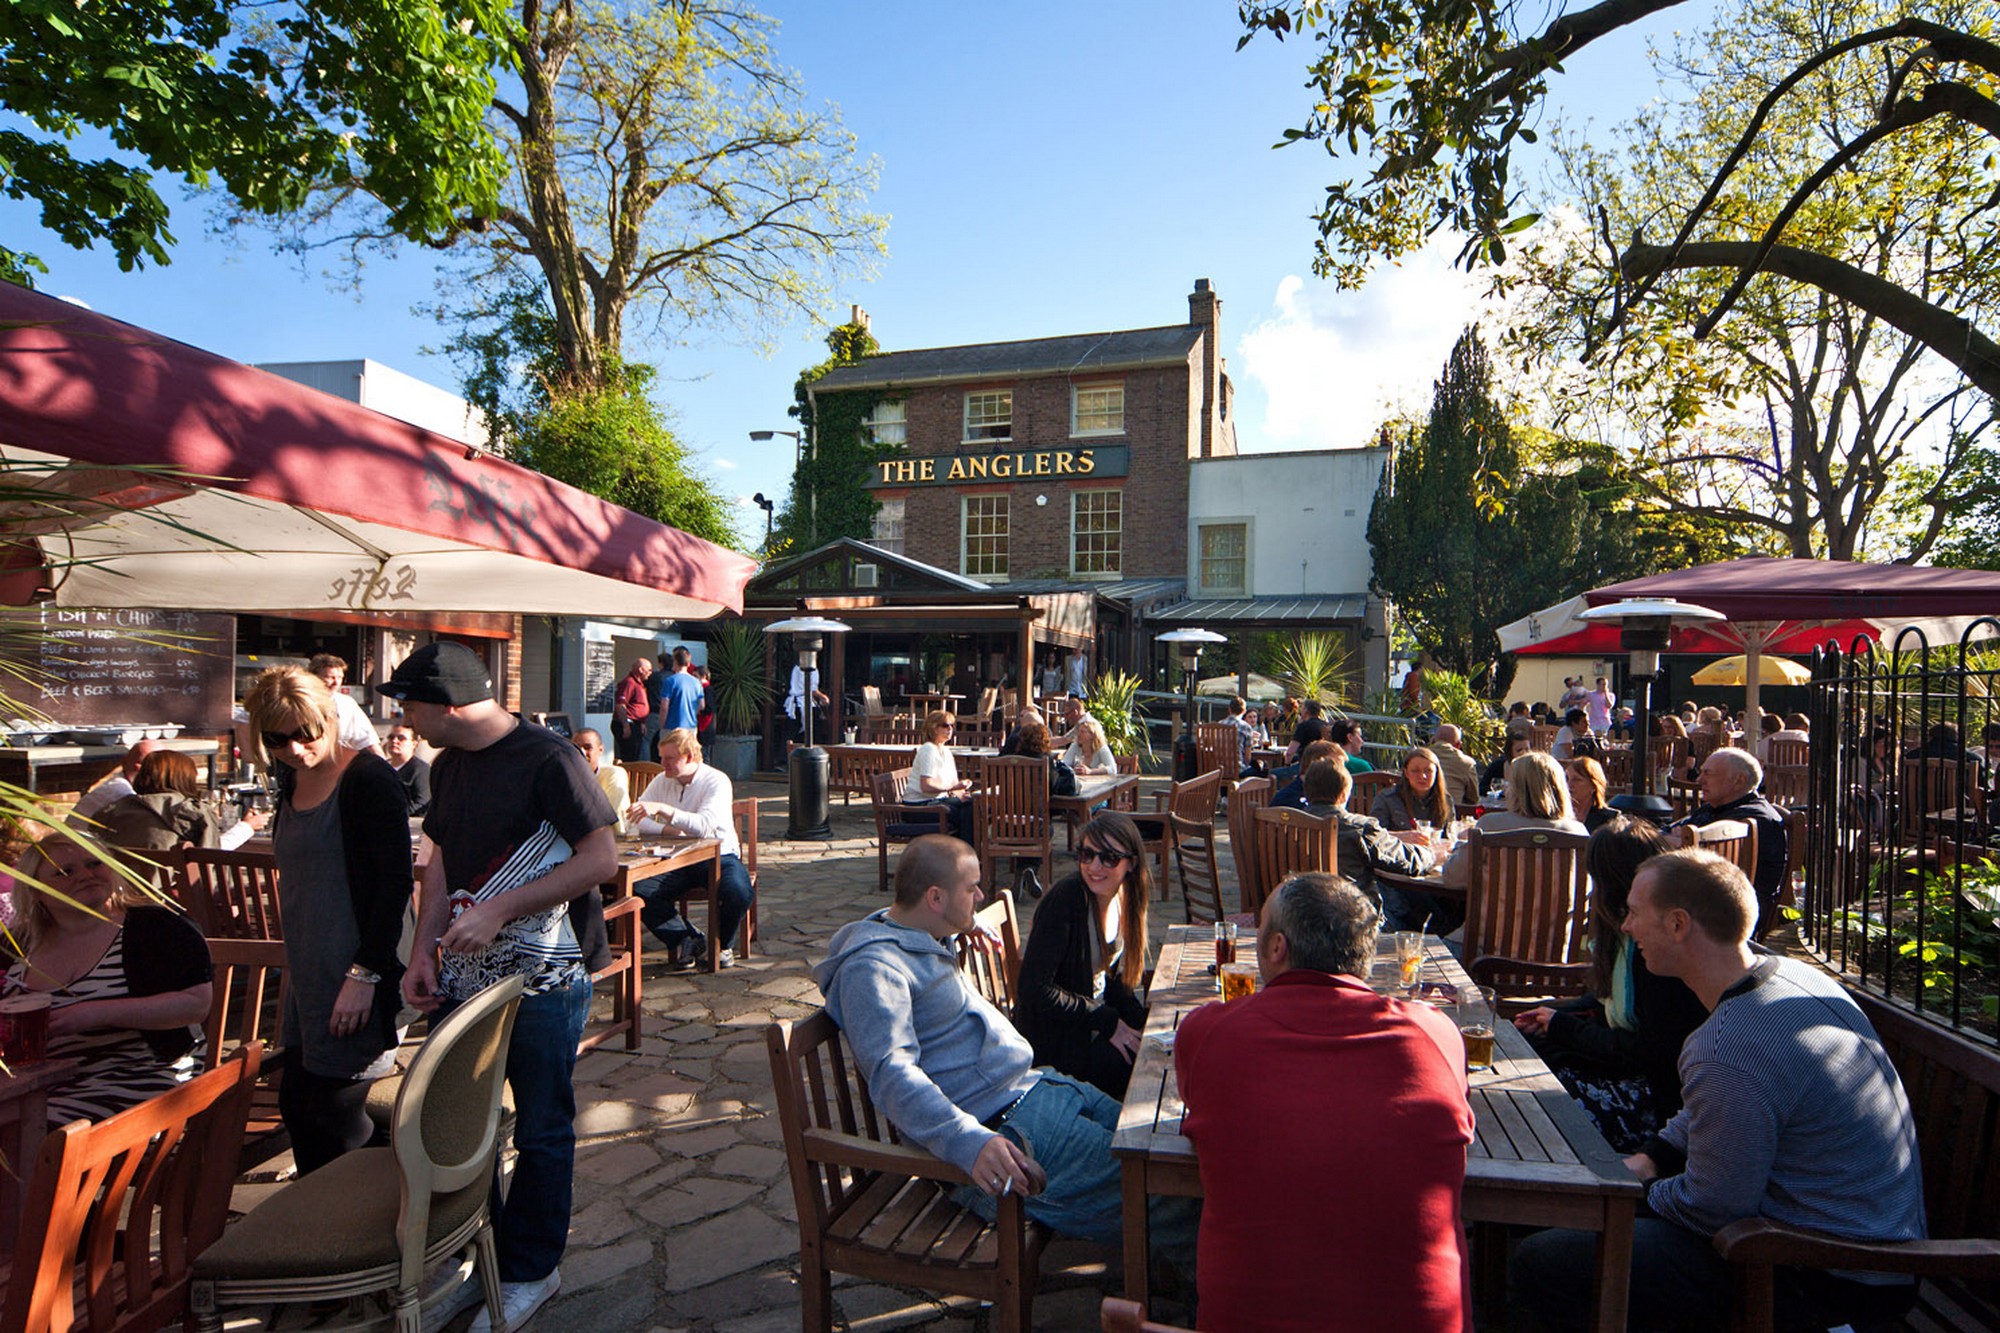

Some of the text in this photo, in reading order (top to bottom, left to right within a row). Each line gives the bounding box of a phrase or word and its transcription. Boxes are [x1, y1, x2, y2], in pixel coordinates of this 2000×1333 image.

[878, 450, 1096, 484] THE ANGLERS
[116, 608, 167, 627] CHIPS
[113, 669, 156, 680] BURGER
